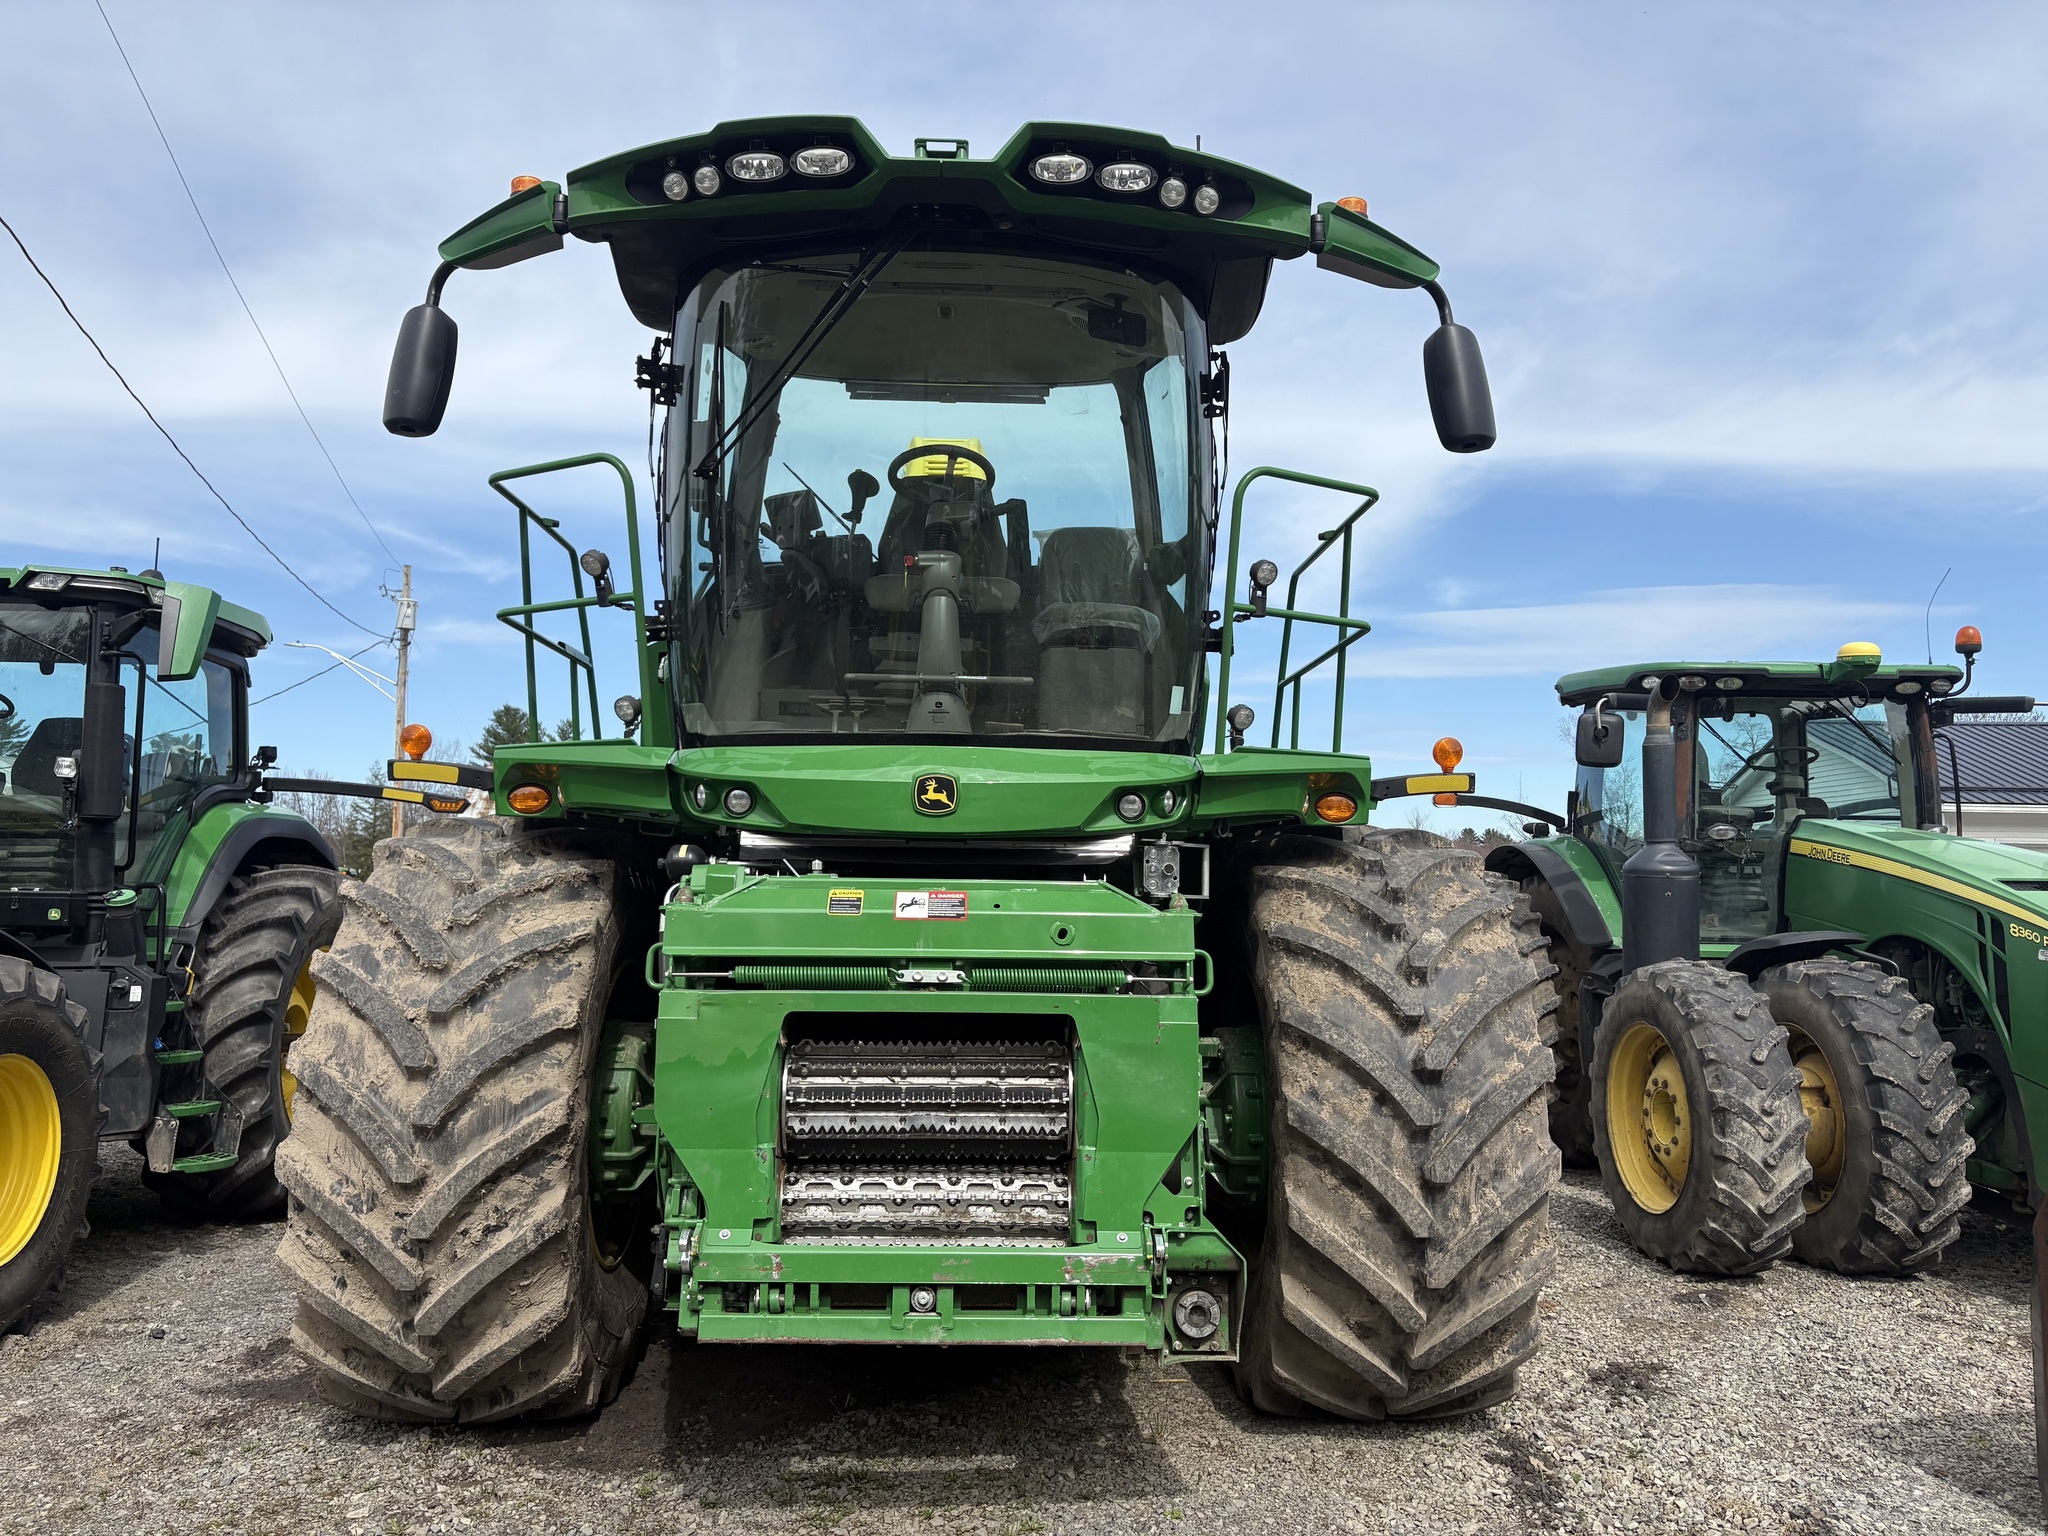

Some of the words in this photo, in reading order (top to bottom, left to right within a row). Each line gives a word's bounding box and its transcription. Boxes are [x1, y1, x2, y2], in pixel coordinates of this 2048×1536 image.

[1807, 845, 1827, 859] JOHN
[1827, 848, 1851, 864] DEERE
[2010, 923, 2041, 943] 8360
